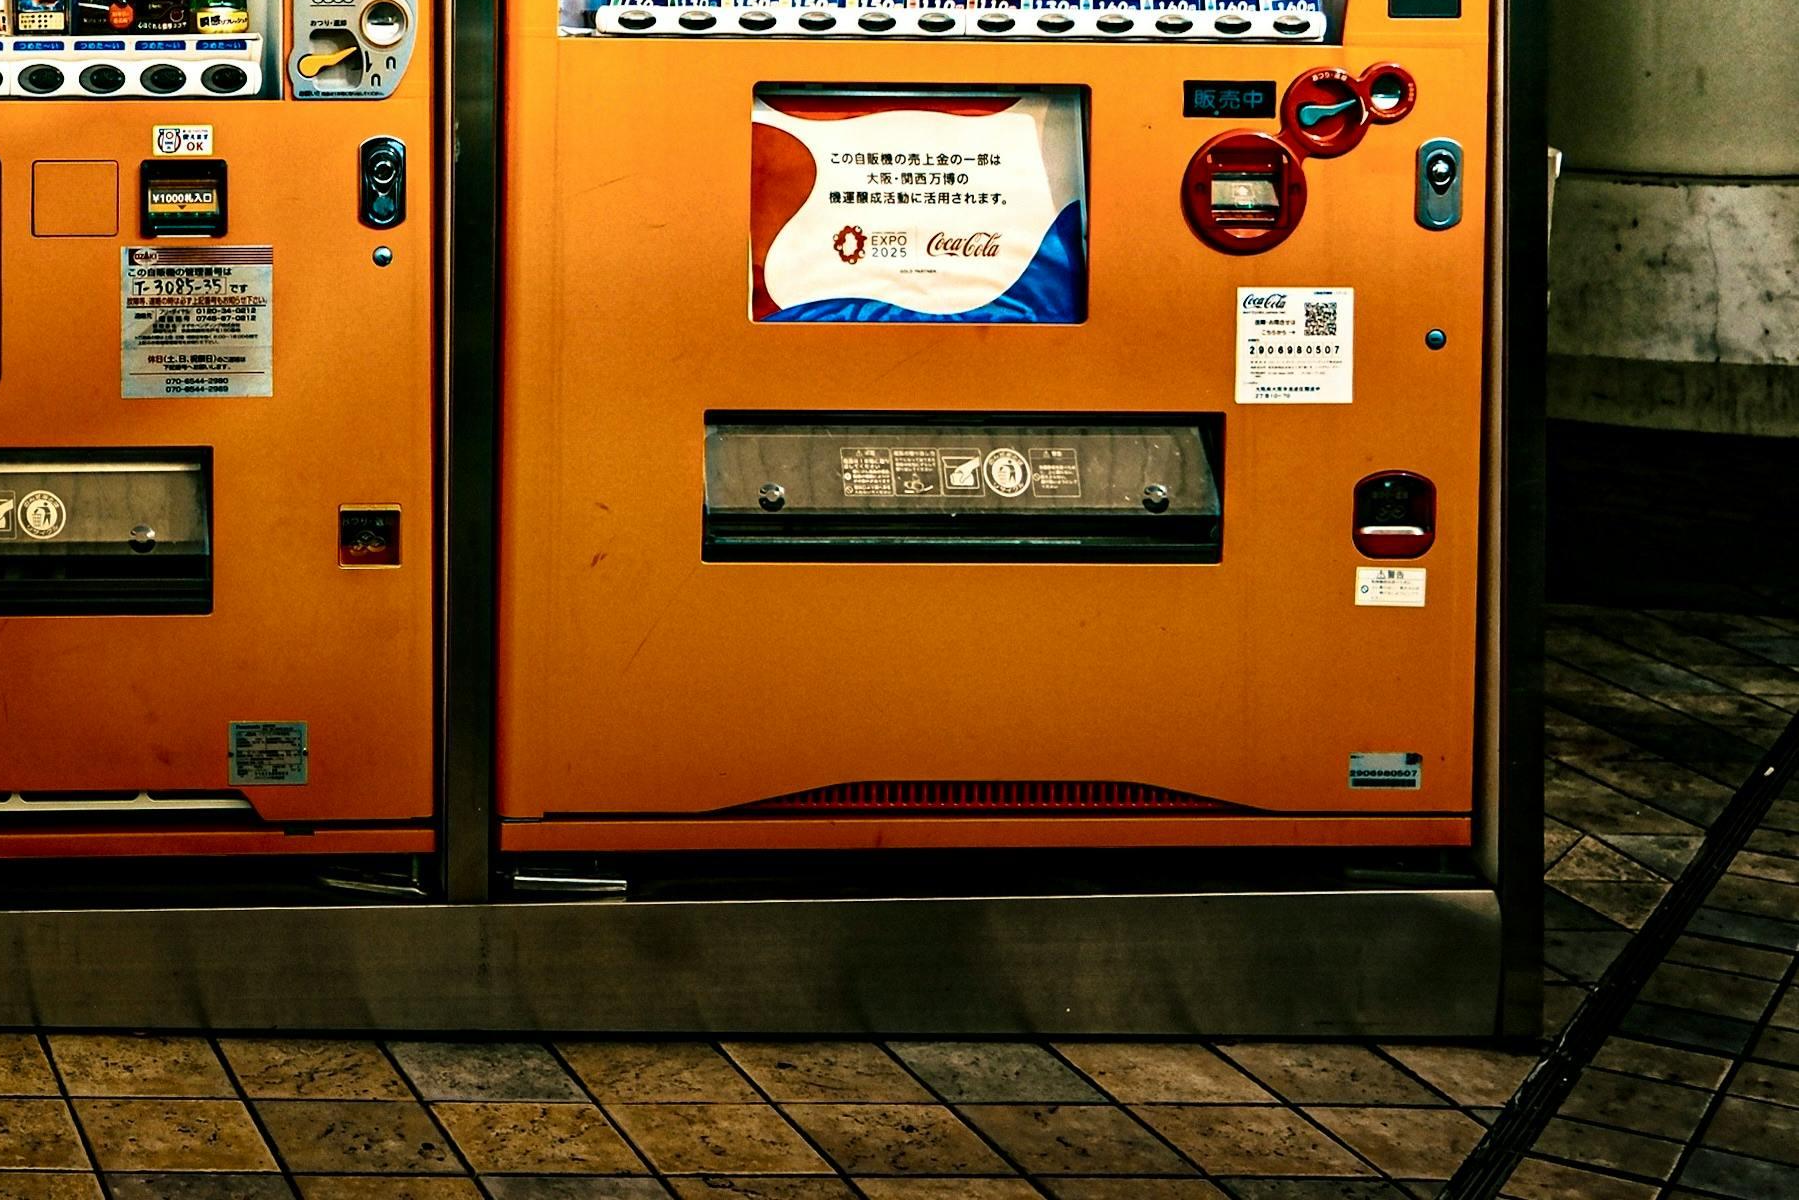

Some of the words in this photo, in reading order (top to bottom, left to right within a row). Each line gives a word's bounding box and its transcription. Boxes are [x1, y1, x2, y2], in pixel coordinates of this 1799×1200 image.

[1194, 89, 1264, 109] 販売中
[186, 141, 204, 151] OK
[830, 152, 1002, 166] この自販機の売上金の一部は
[867, 172, 970, 186] 大阪・関西万博の
[152, 193, 212, 203] ¥1000札入口
[829, 191, 1007, 206] 機運醸成活動に活用されます。
[871, 234, 907, 247] EXPO
[926, 231, 1002, 258] Coca-Cola
[872, 247, 907, 258] 2025
[128, 268, 232, 277] この自販機の管理番号は
[135, 278, 222, 295] T-3085-35
[229, 284, 248, 293] です
